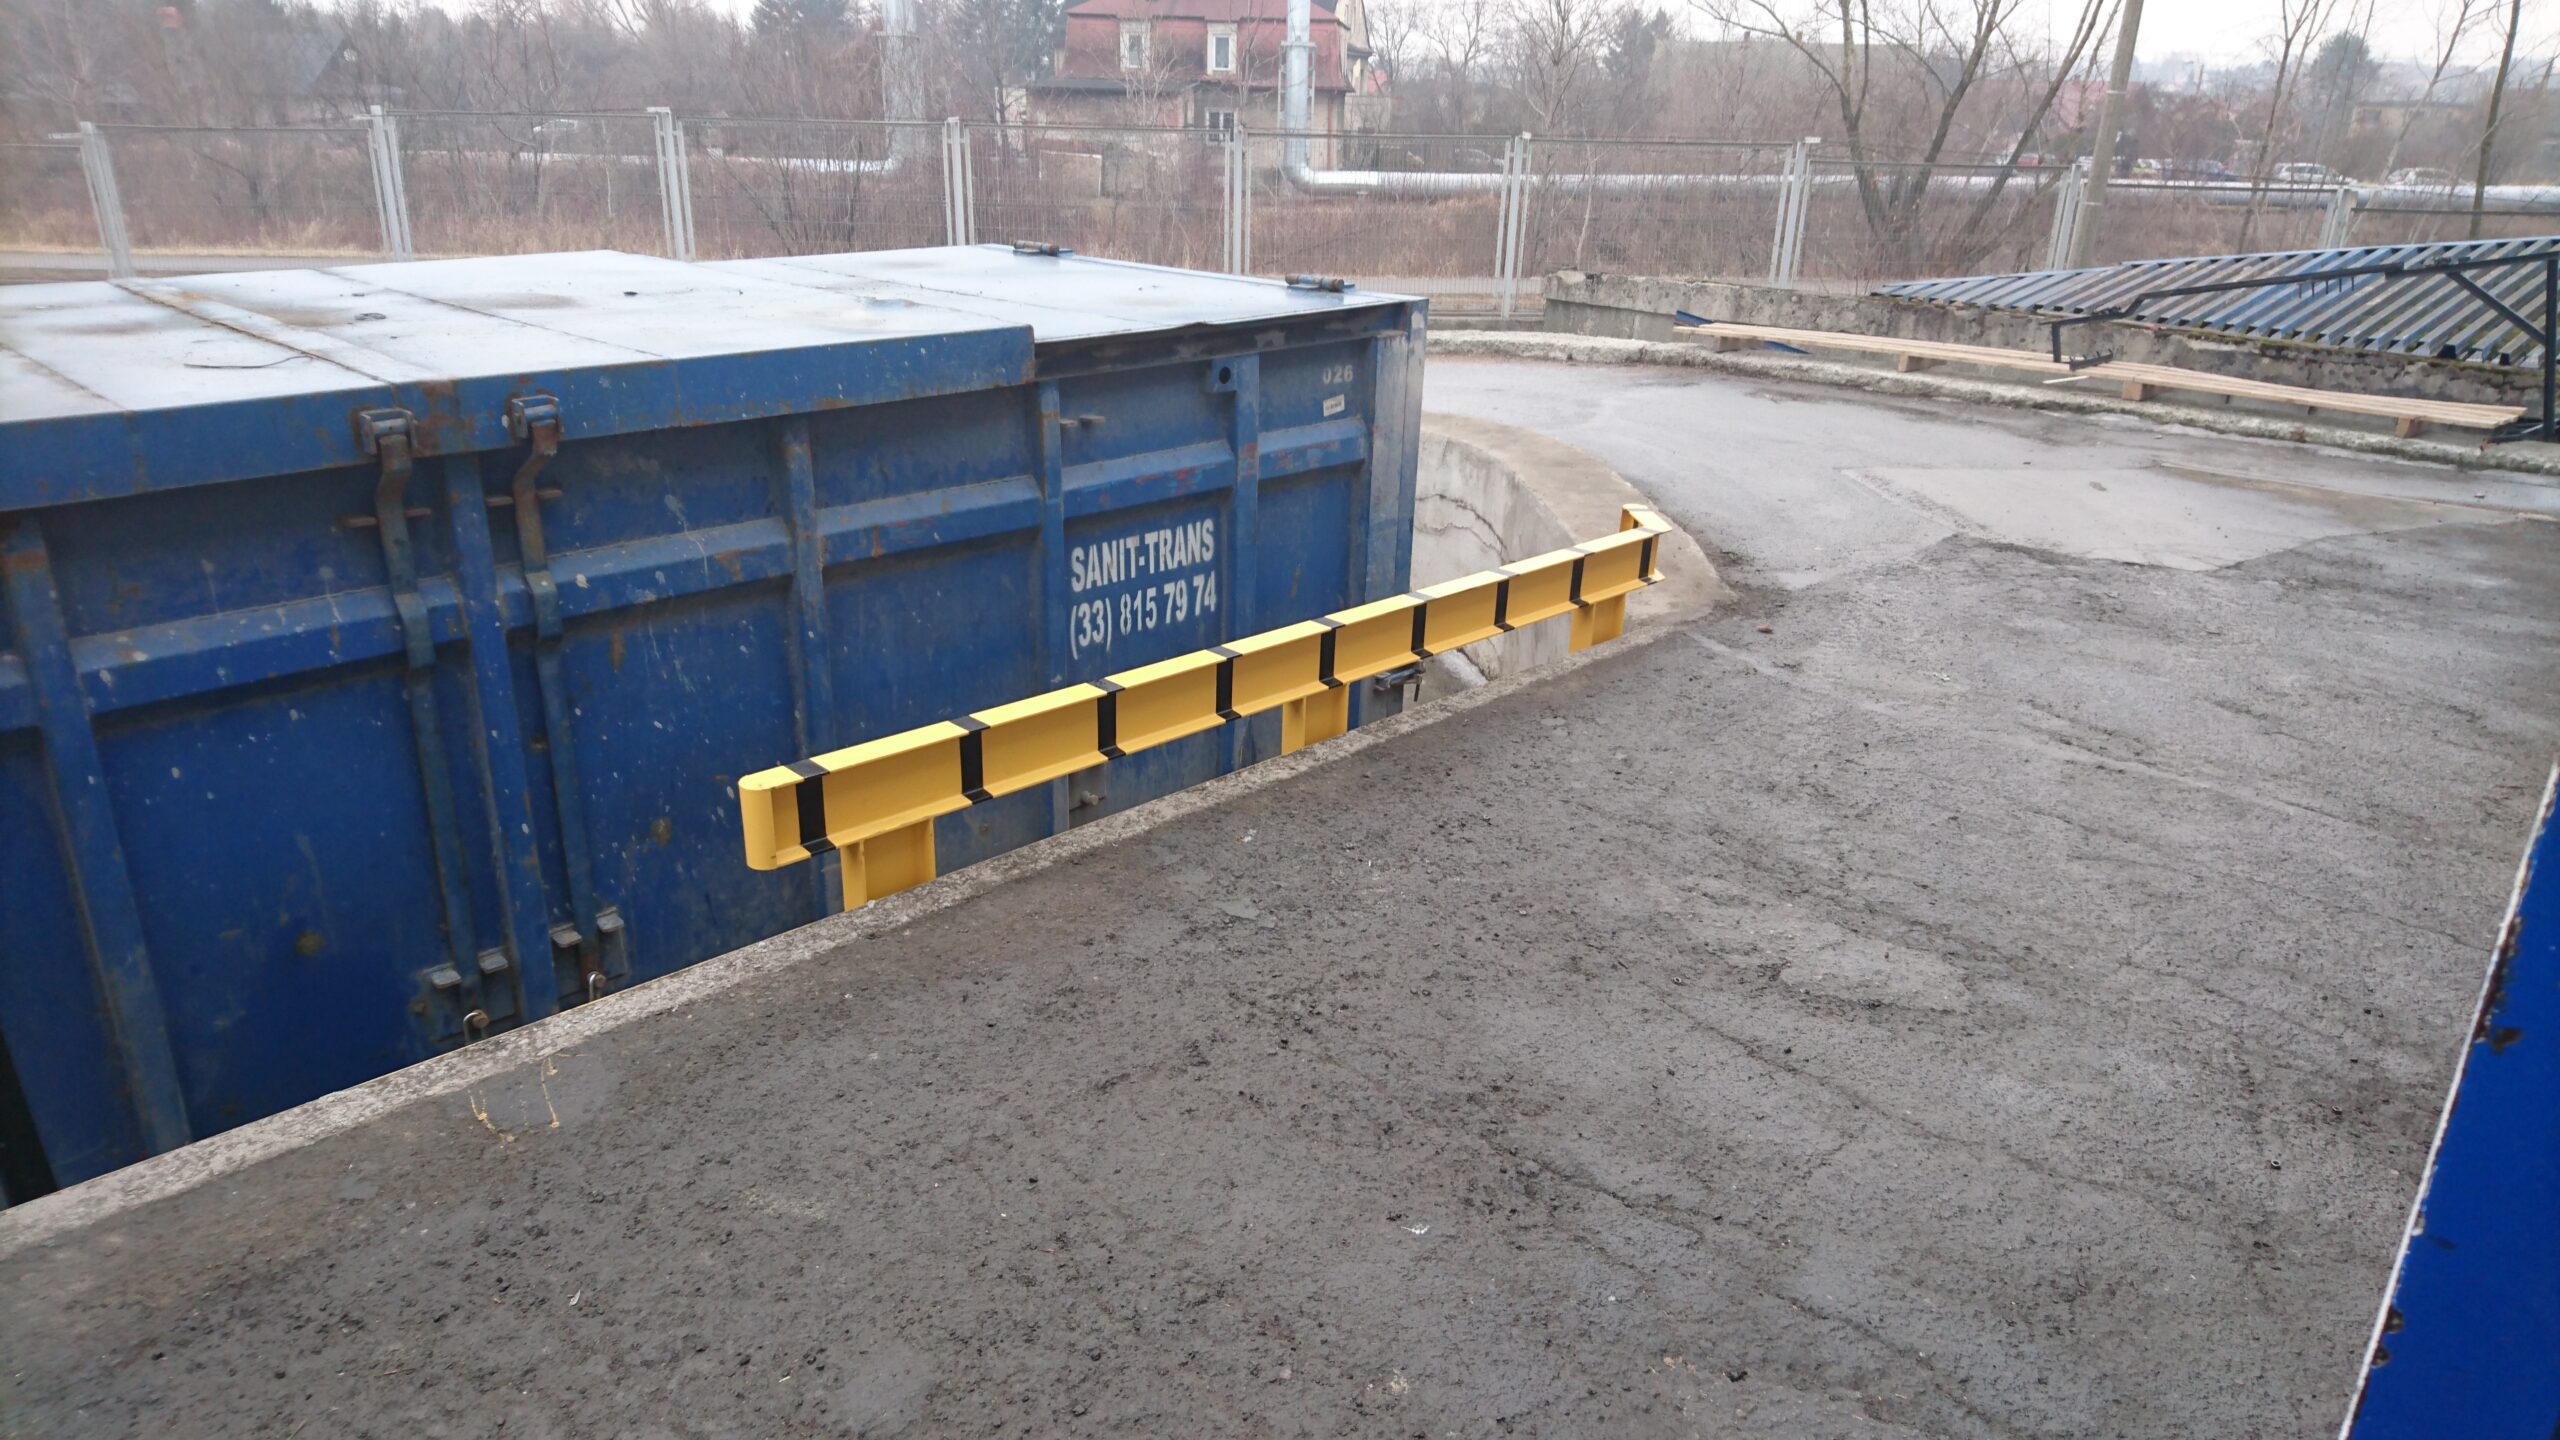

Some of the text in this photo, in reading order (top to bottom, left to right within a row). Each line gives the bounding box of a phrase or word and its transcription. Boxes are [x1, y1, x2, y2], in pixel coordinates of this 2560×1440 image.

[1323, 364, 1353, 384] 026
[1071, 518, 1215, 592] SANIT-TRANS
[1070, 571, 1217, 660] (33) 815 79 74
